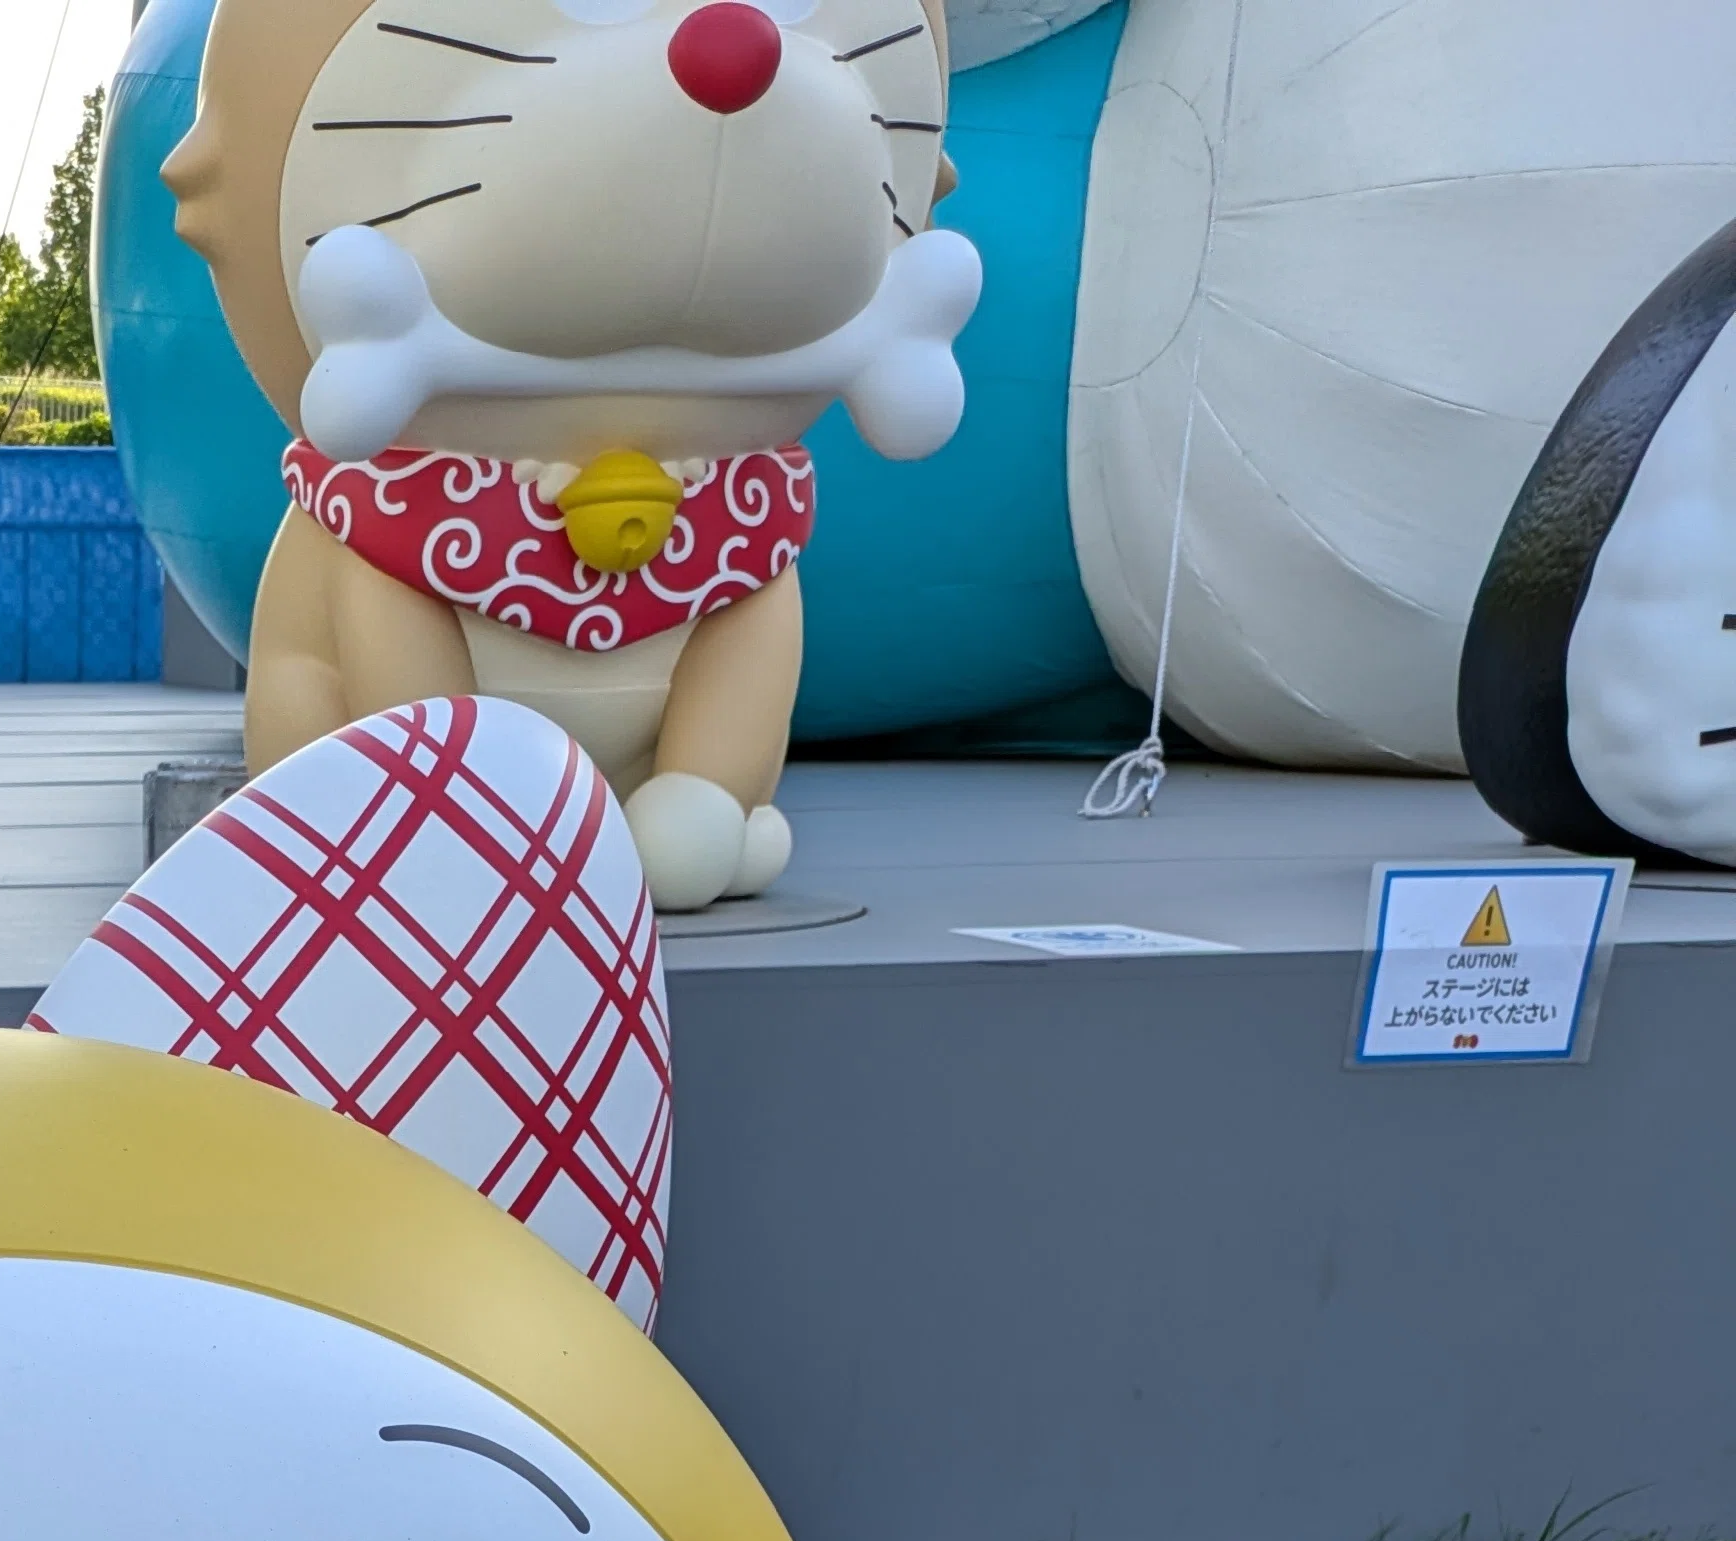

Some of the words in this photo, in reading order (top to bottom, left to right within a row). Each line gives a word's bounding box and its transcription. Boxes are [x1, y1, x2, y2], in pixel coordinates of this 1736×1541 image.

[1447, 953, 1517, 970] CAUTION!
[1422, 977, 1531, 1000] ステージには
[1384, 1003, 1558, 1028] 上がらないでください
